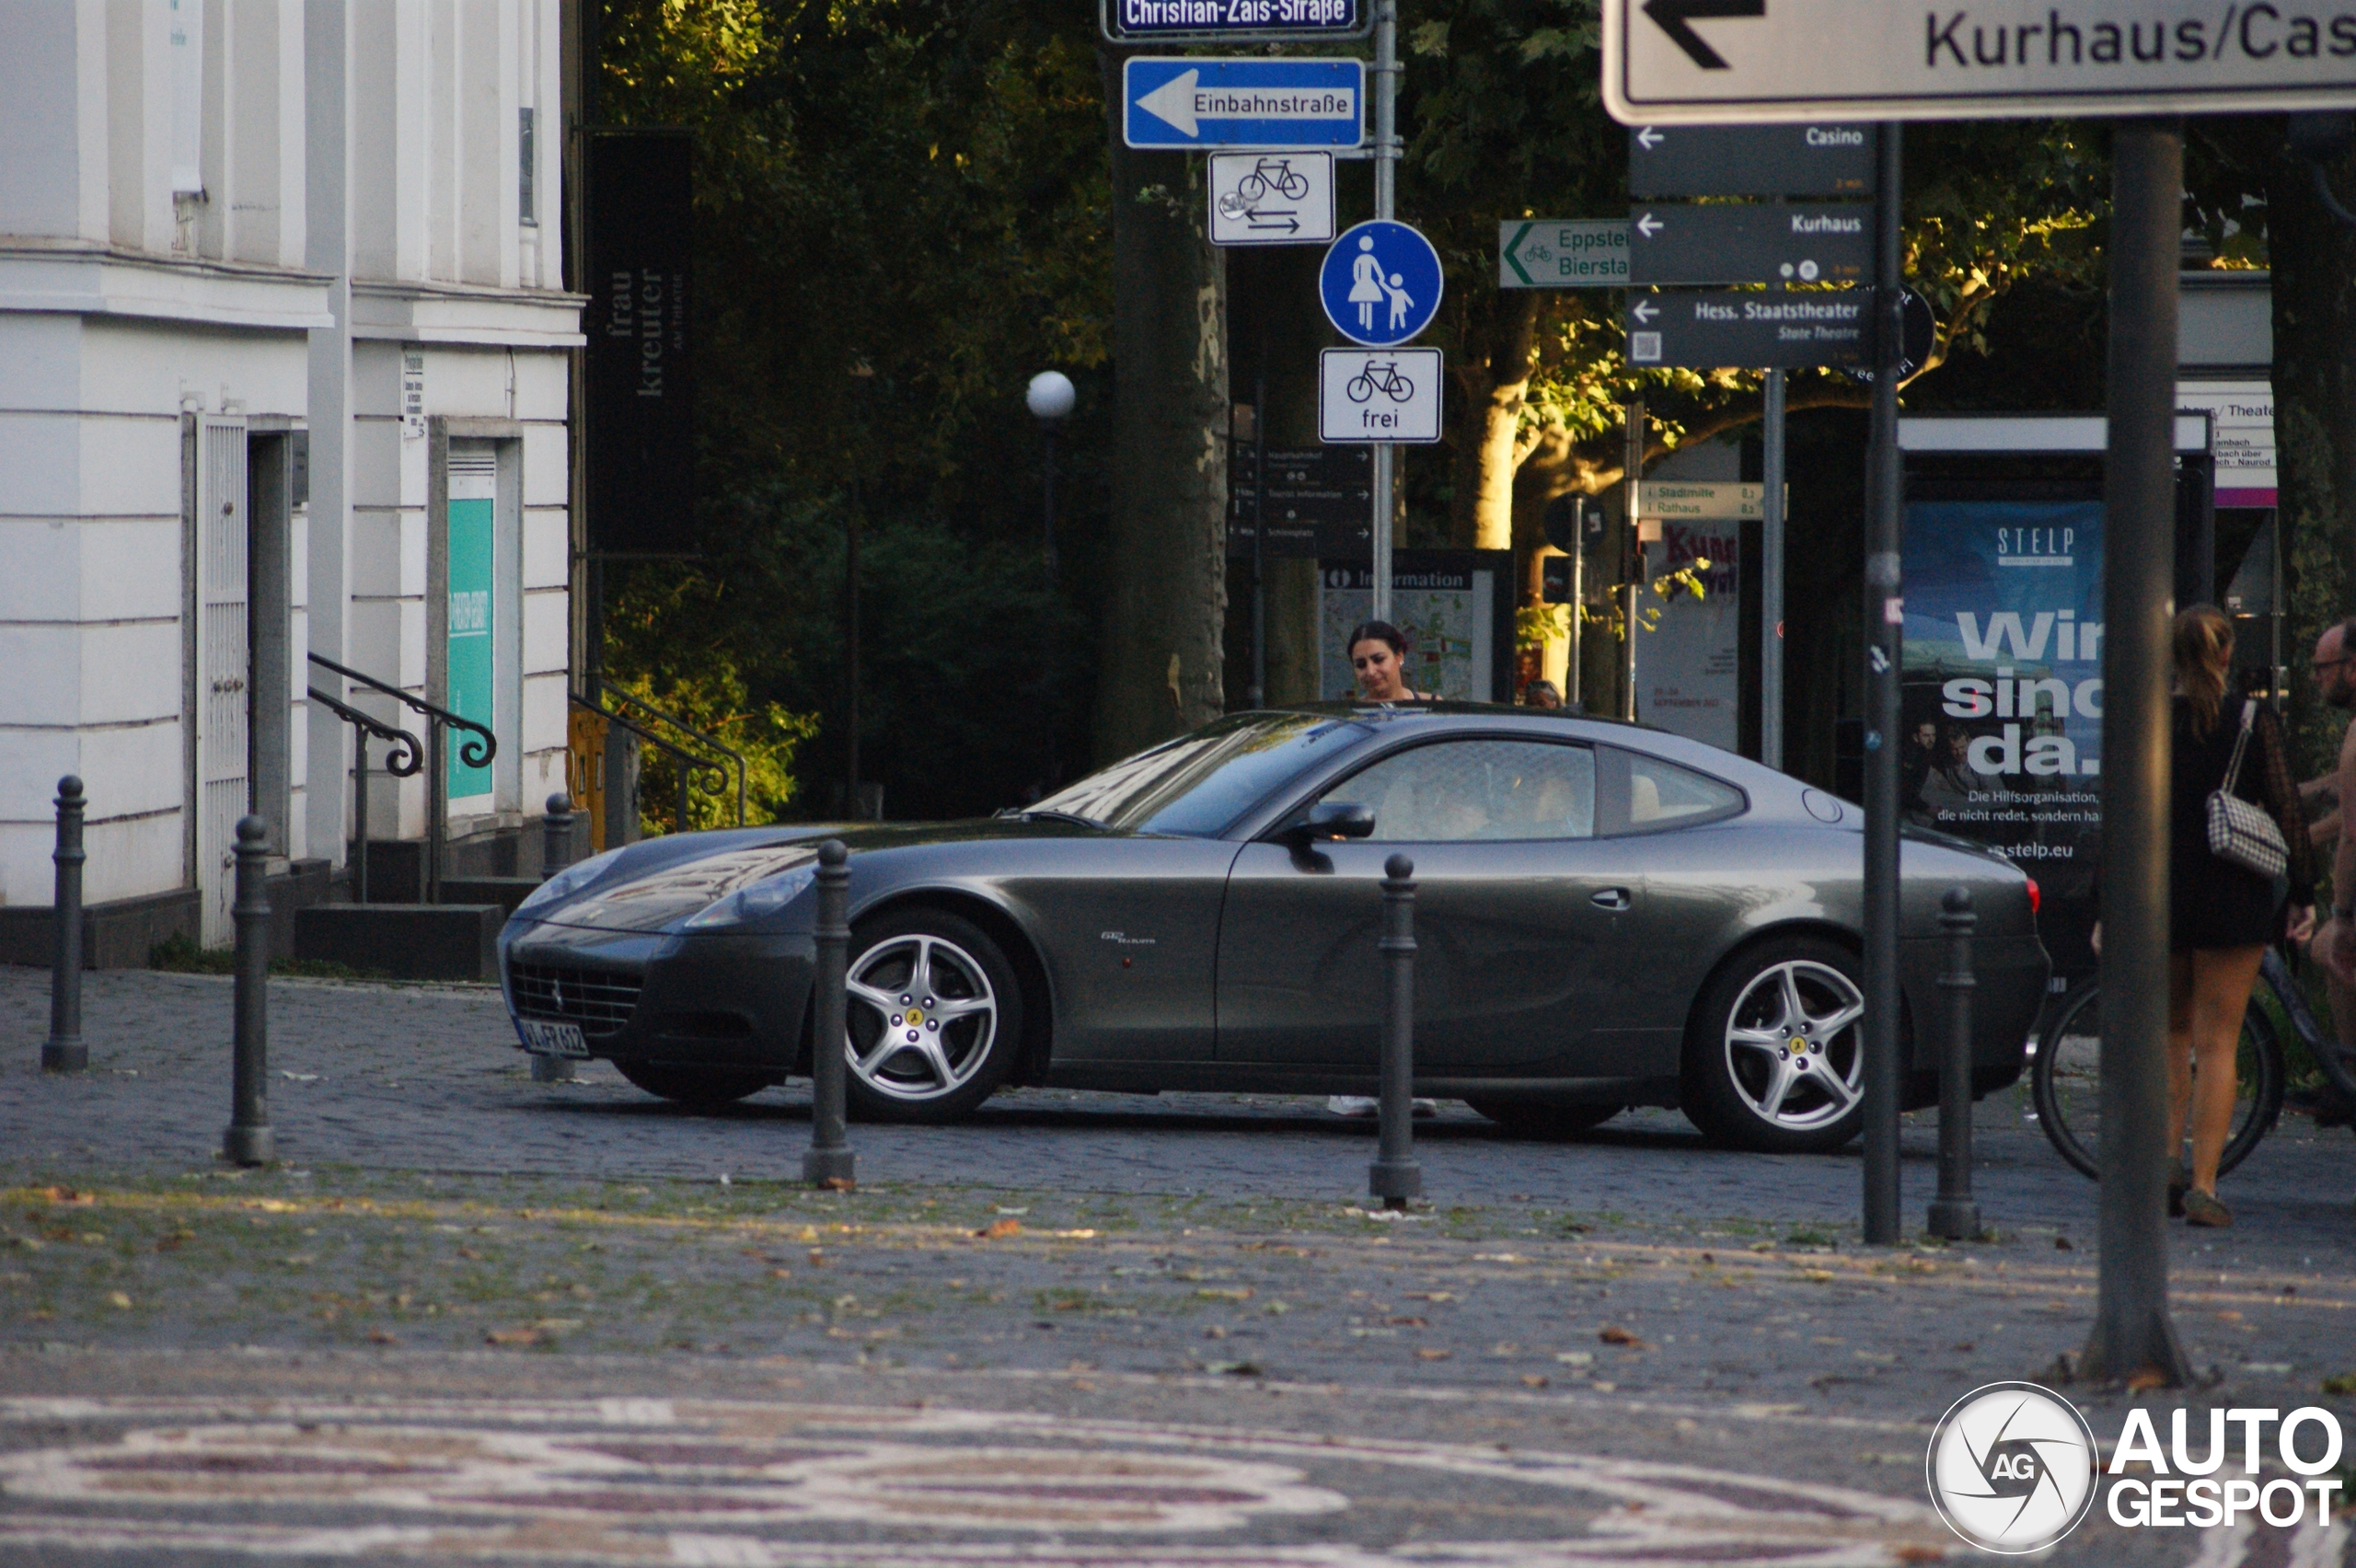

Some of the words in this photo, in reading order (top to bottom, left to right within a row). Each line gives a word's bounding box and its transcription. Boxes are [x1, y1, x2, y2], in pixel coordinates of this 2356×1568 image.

[1126, 0, 1345, 25] Christian-Zais-Straße
[1195, 94, 1347, 113] Einbahnstraße
[1806, 127, 1863, 145] Casino
[1791, 214, 1862, 232] Kurhaus
[1559, 258, 1628, 275] Biersta
[606, 271, 632, 337] frau
[1695, 302, 1739, 319] Hess.
[1744, 301, 1859, 319] Staatstheater
[637, 268, 663, 397] kreuter
[1362, 409, 1398, 428] frei
[2237, 458, 2271, 467] Naurod
[1658, 487, 1715, 498] Stadtmitte
[1657, 502, 1701, 513] Rathaus
[1998, 527, 2073, 554] STELP
[1359, 570, 1463, 587] Inrmation
[1955, 608, 2105, 661] Wir
[1967, 723, 2101, 775] da.
[1968, 790, 1990, 802] Die
[1992, 790, 2099, 805] Hilfsorganisation,
[1937, 810, 1957, 822] die
[1959, 810, 1990, 822] nicht
[1992, 810, 2029, 823] redet,
[2031, 810, 2081, 822] sondern
[559, 1026, 586, 1051] 612
